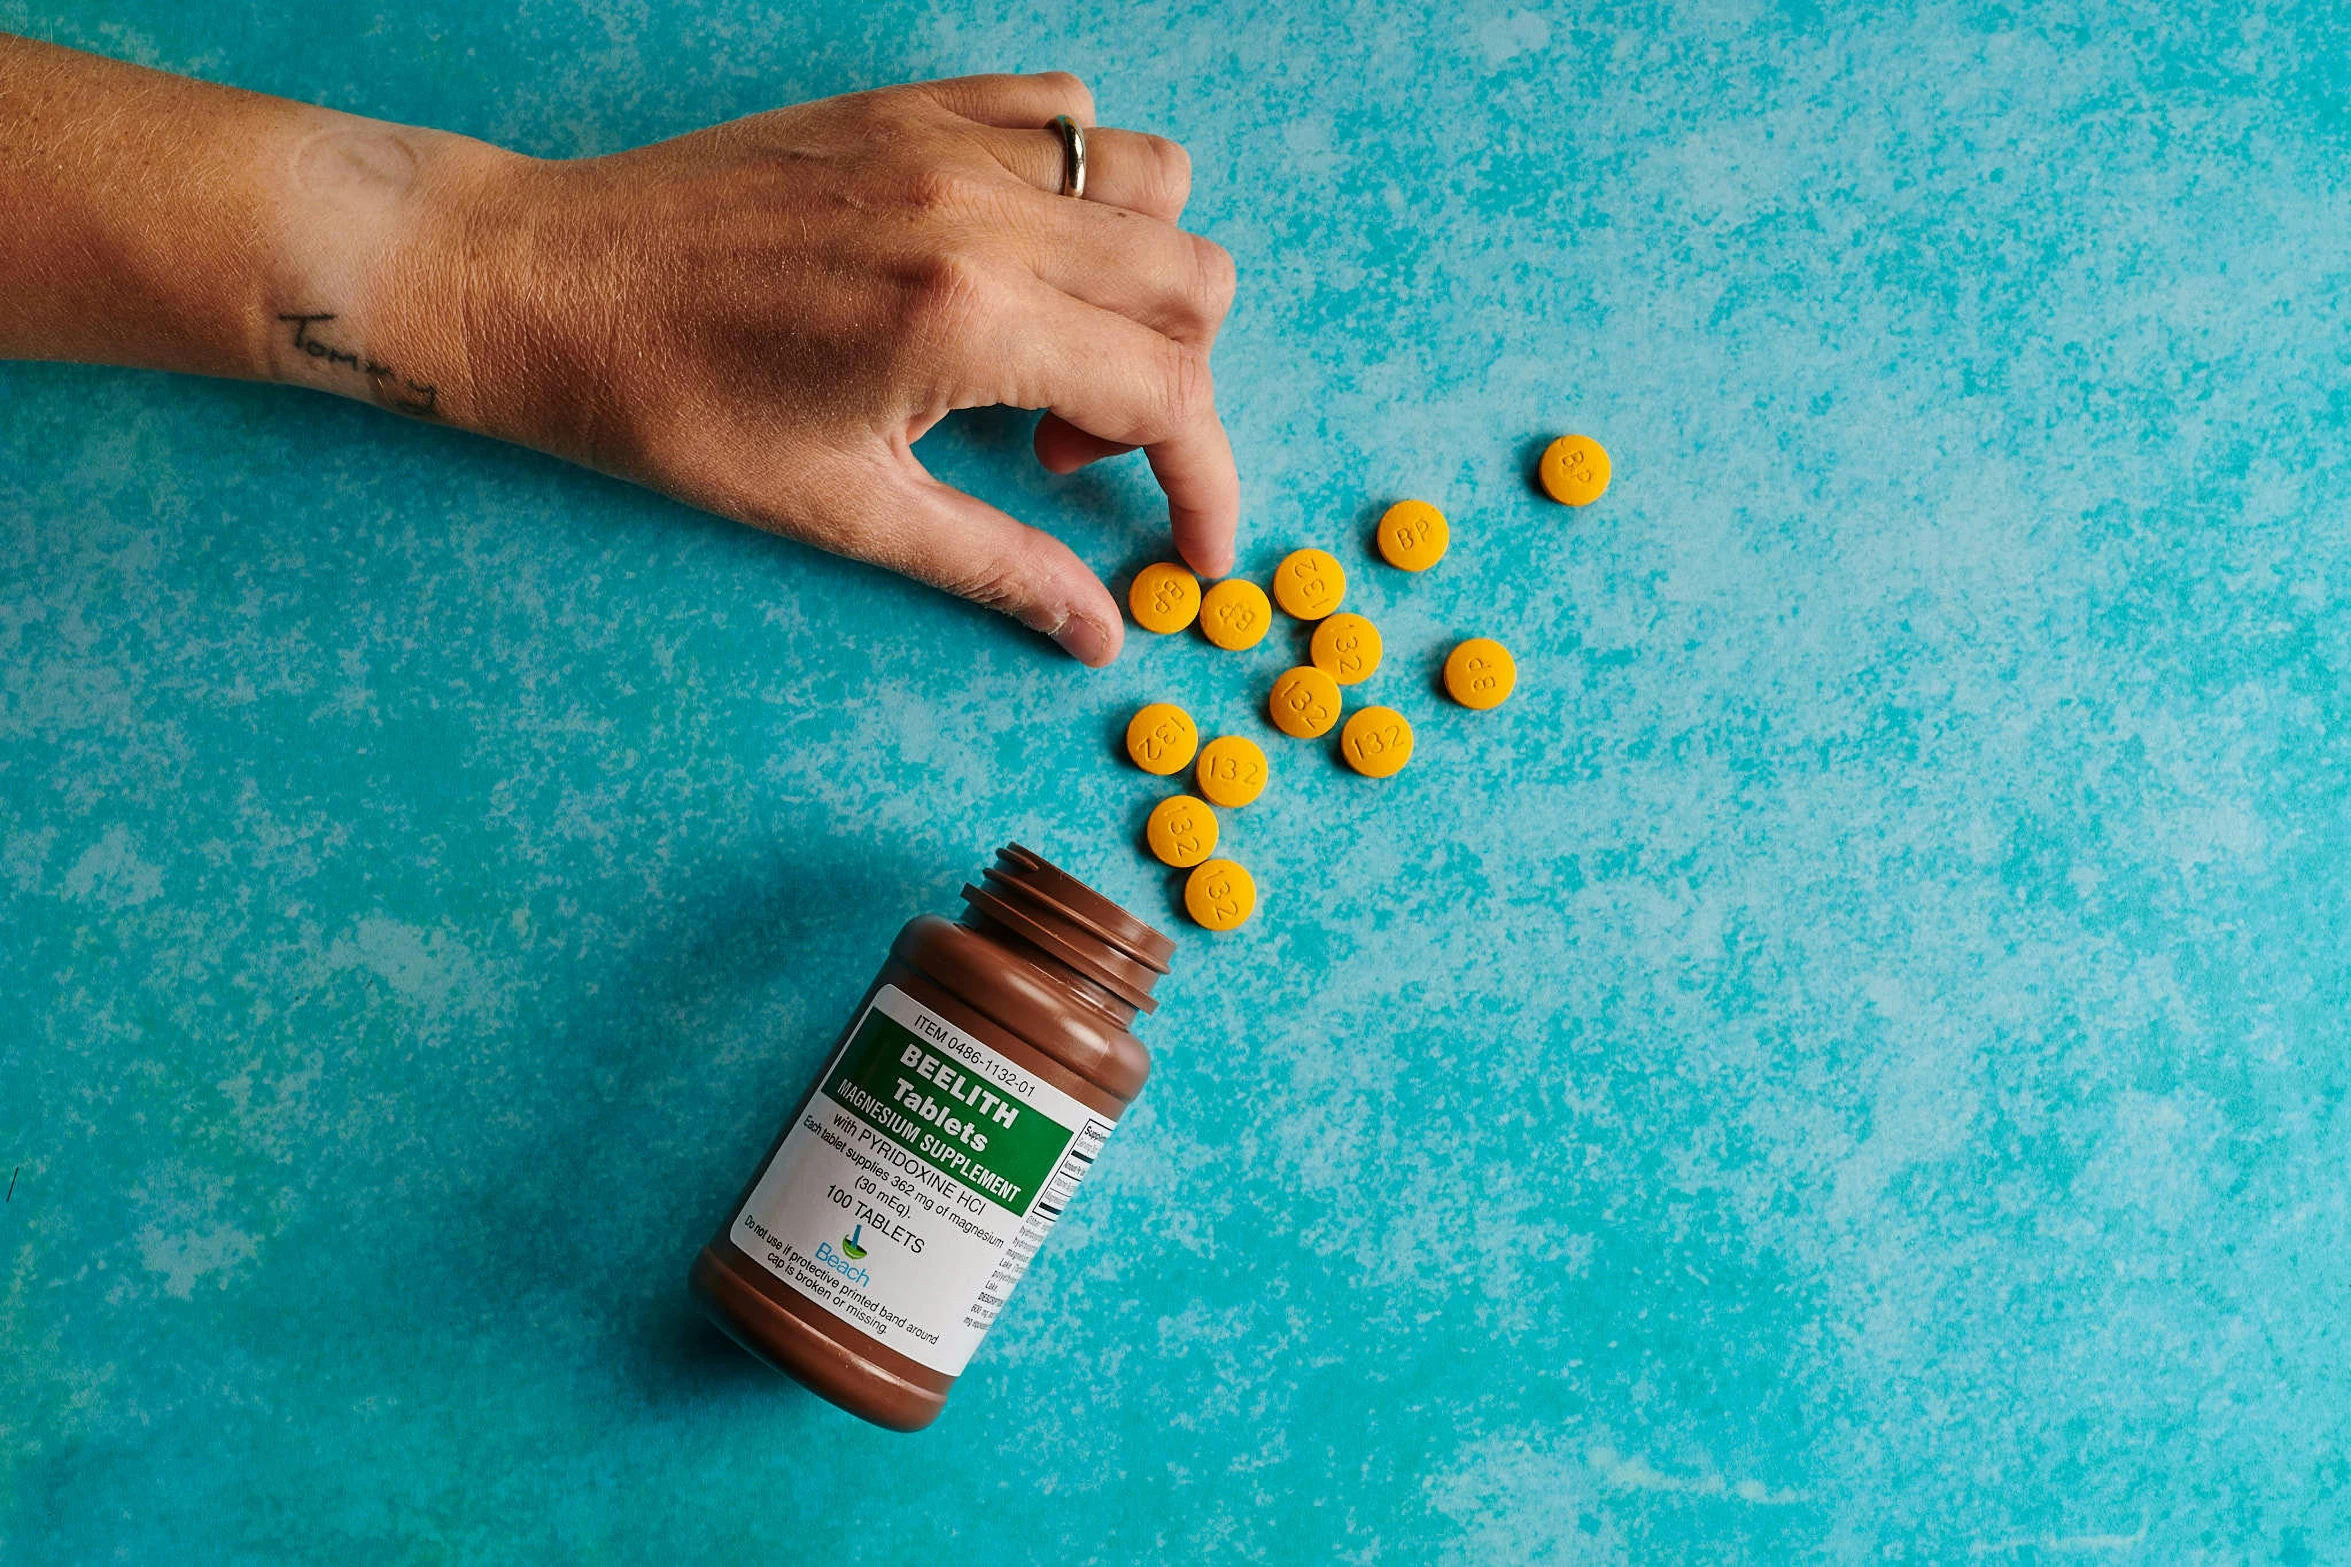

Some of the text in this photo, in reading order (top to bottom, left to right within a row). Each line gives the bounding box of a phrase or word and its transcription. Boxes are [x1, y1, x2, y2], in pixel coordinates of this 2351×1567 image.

[1396, 518, 1430, 552] BP
[1294, 558, 1331, 609] 132
[1335, 624, 1363, 674] 132
[1281, 680, 1328, 730] 132
[1137, 716, 1185, 762] 132
[1351, 725, 1405, 761] 132
[1209, 755, 1259, 786] 132
[1164, 805, 1200, 860] 132
[1202, 870, 1239, 922] 132
[914, 1014, 1036, 1098] ITEM 0486-1132-01
[900, 1043, 1020, 1130] BEELITH
[837, 1078, 1022, 1203] MAGNESIUM SUPPLEMENT
[893, 1077, 989, 1152] Tablets
[803, 1114, 822, 1136] Each
[821, 1126, 847, 1153] tablet
[846, 1147, 890, 1181] supplies
[890, 1176, 915, 1197] 362
[914, 1193, 934, 1211] mg
[936, 1203, 950, 1219] of
[949, 1211, 1005, 1249] magnesium
[833, 1113, 857, 1137] with
[857, 1129, 958, 1199] PYRIDOXINE
[826, 1184, 926, 1254] 100 TABLETS
[854, 1175, 911, 1219] (30 mEq).
[744, 1214, 940, 1345] Do not use if protective printed band around
[815, 1241, 870, 1288] Beach
[767, 1252, 888, 1334] cap is broken or missing.
